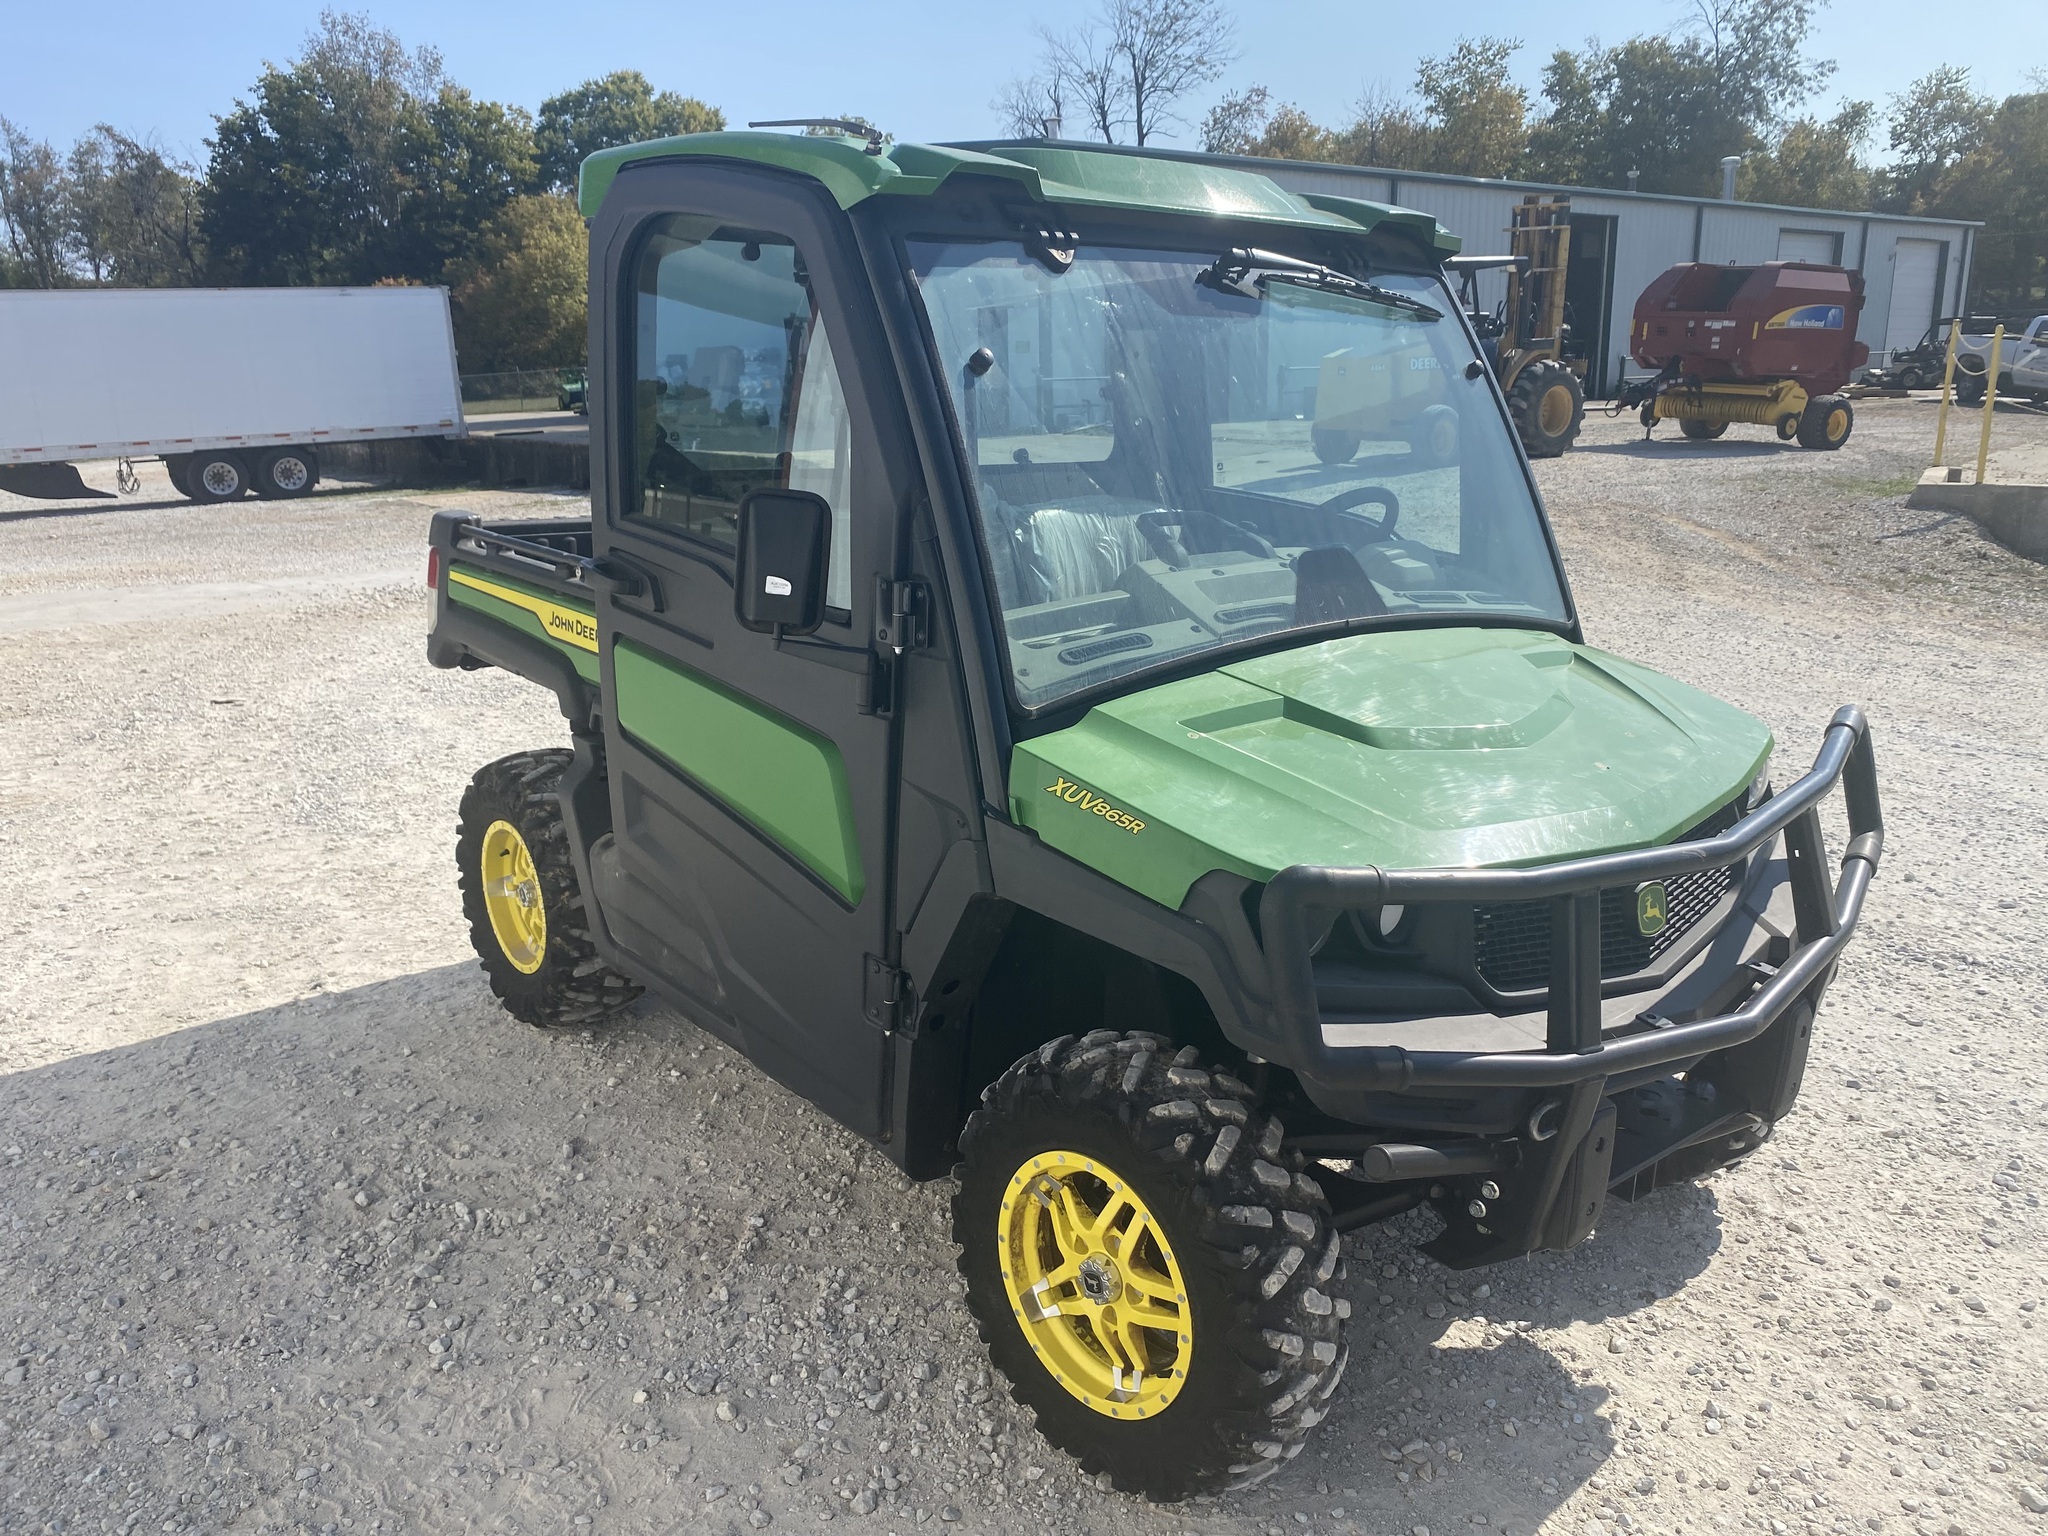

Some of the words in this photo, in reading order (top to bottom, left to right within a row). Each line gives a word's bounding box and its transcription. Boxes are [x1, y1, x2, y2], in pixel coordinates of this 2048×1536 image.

[1789, 319, 1803, 327] New
[1803, 318, 1826, 328] Holland
[1410, 357, 1449, 370] DEER
[549, 611, 575, 634] JOHN
[1043, 775, 1148, 836] XUV865R
